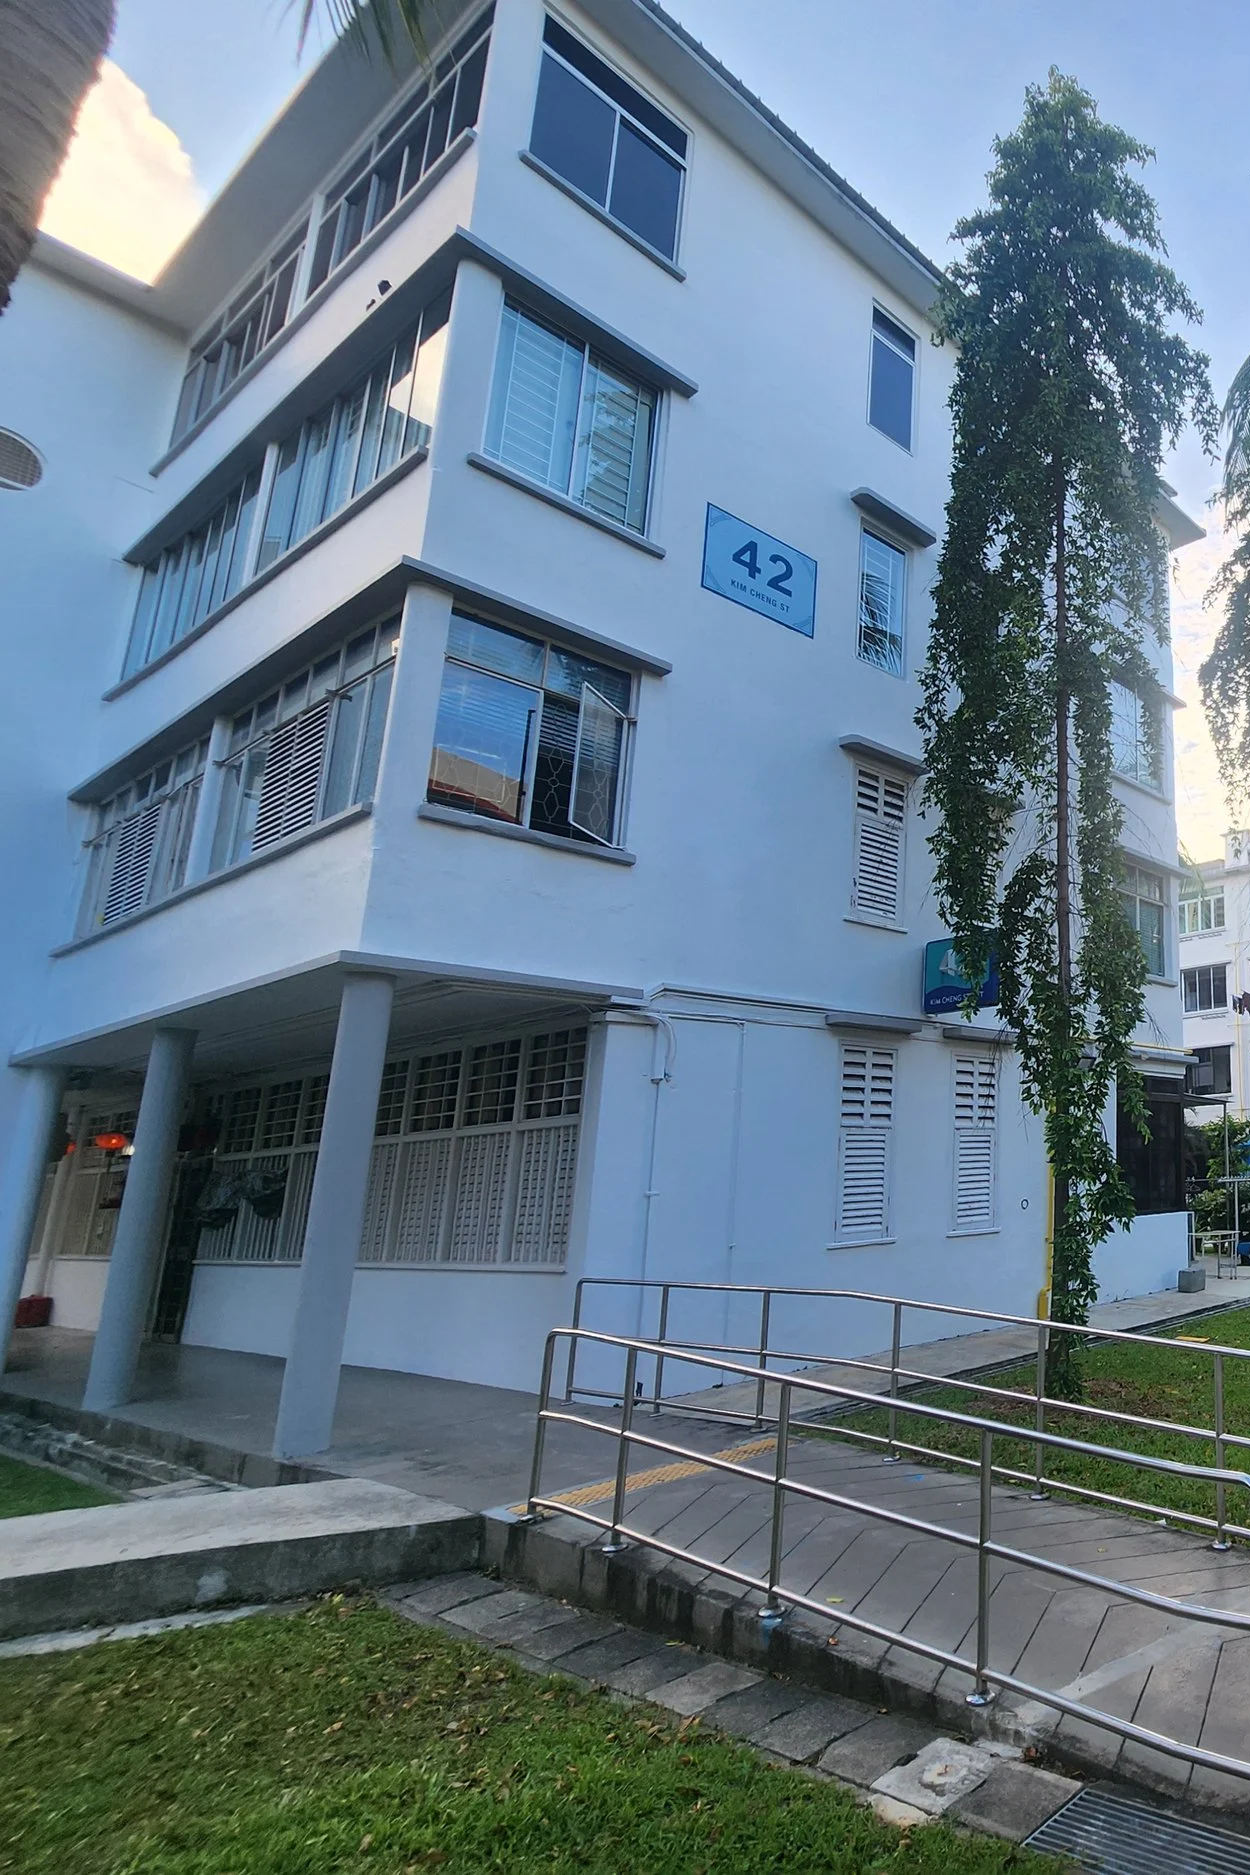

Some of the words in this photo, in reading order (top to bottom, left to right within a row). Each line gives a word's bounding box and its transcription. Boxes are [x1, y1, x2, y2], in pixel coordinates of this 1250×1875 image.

[732, 540, 793, 598] 42
[730, 579, 747, 593] KIM
[750, 588, 777, 608] CHENG
[780, 603, 790, 613] ST
